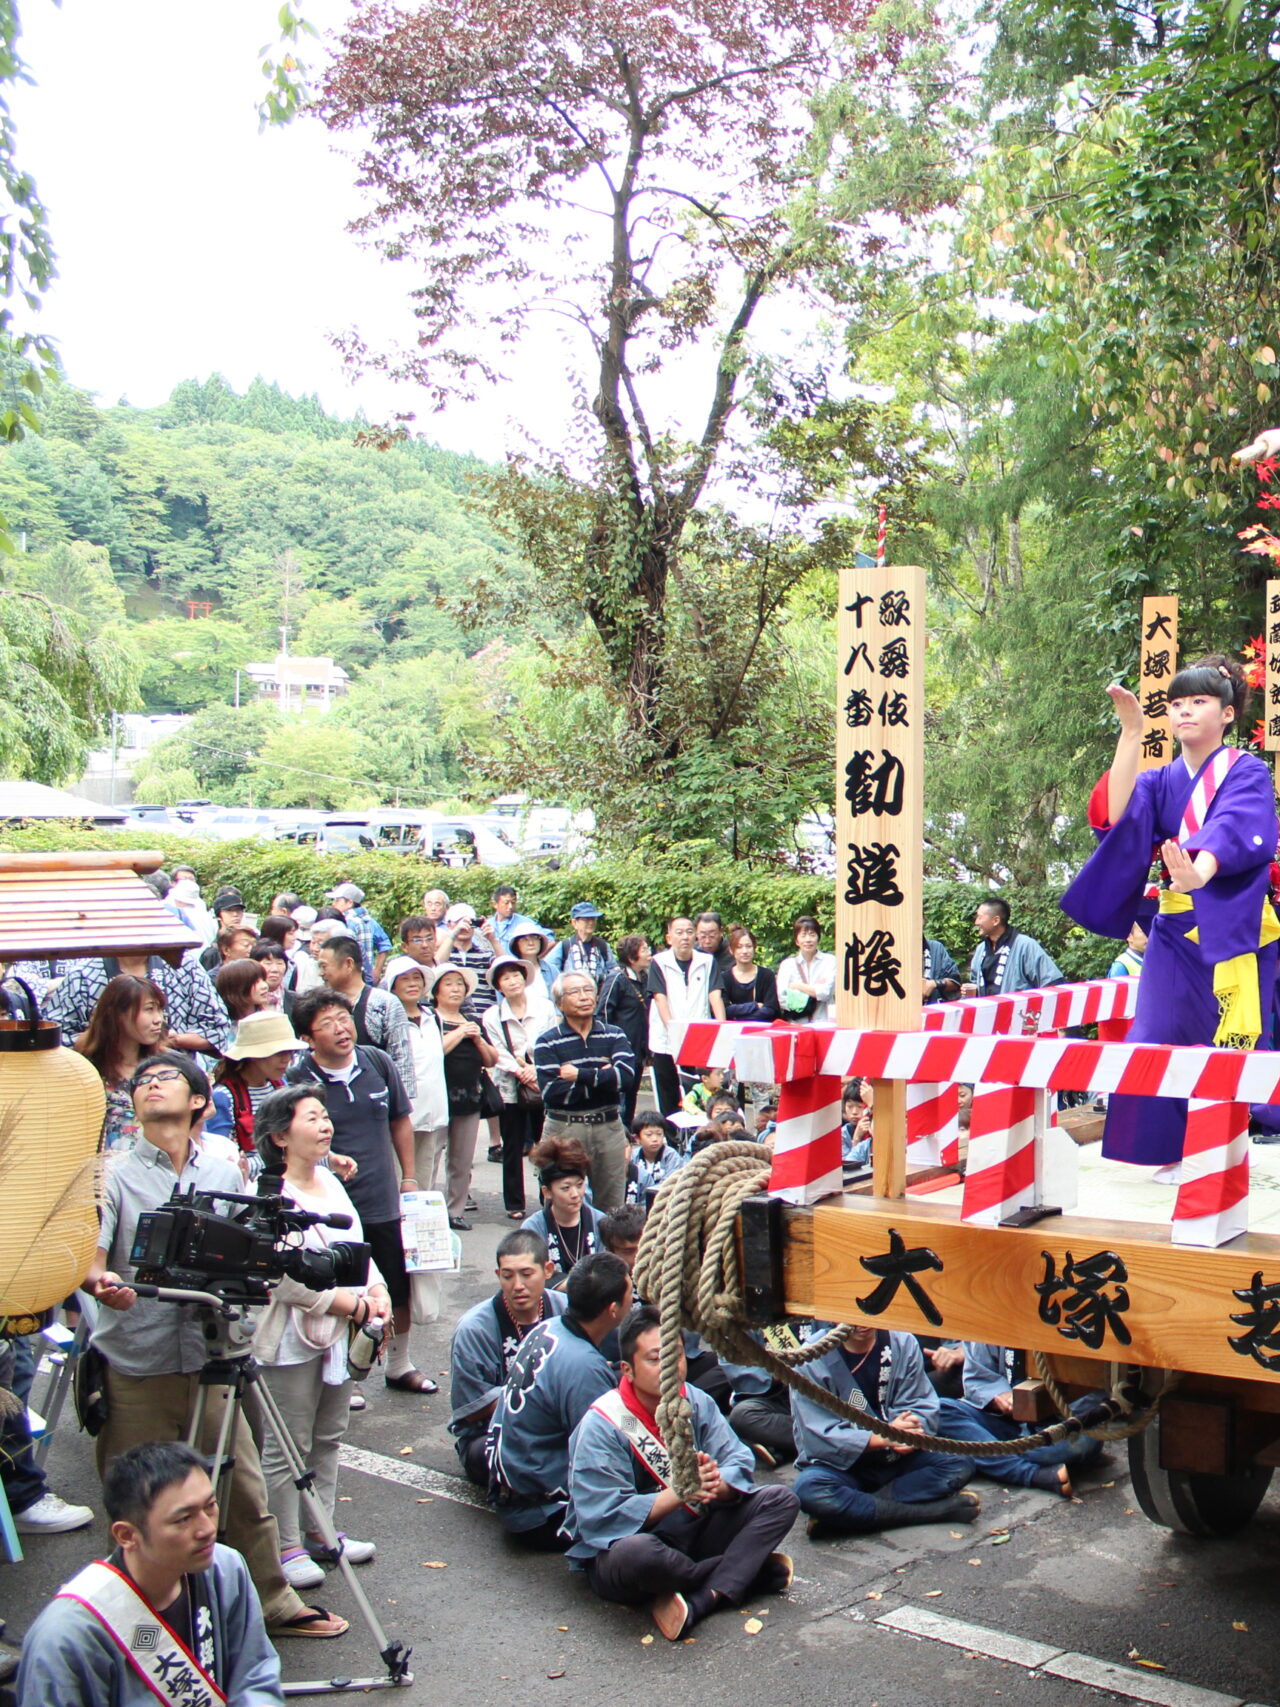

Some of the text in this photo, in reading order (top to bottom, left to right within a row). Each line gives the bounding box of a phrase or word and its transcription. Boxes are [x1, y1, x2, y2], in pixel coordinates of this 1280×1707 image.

[843, 590, 875, 728] 十八番
[878, 590, 911, 728] 歌舞伎
[1141, 611, 1173, 759] 大塚若者
[844, 749, 906, 1000] 勧進帳
